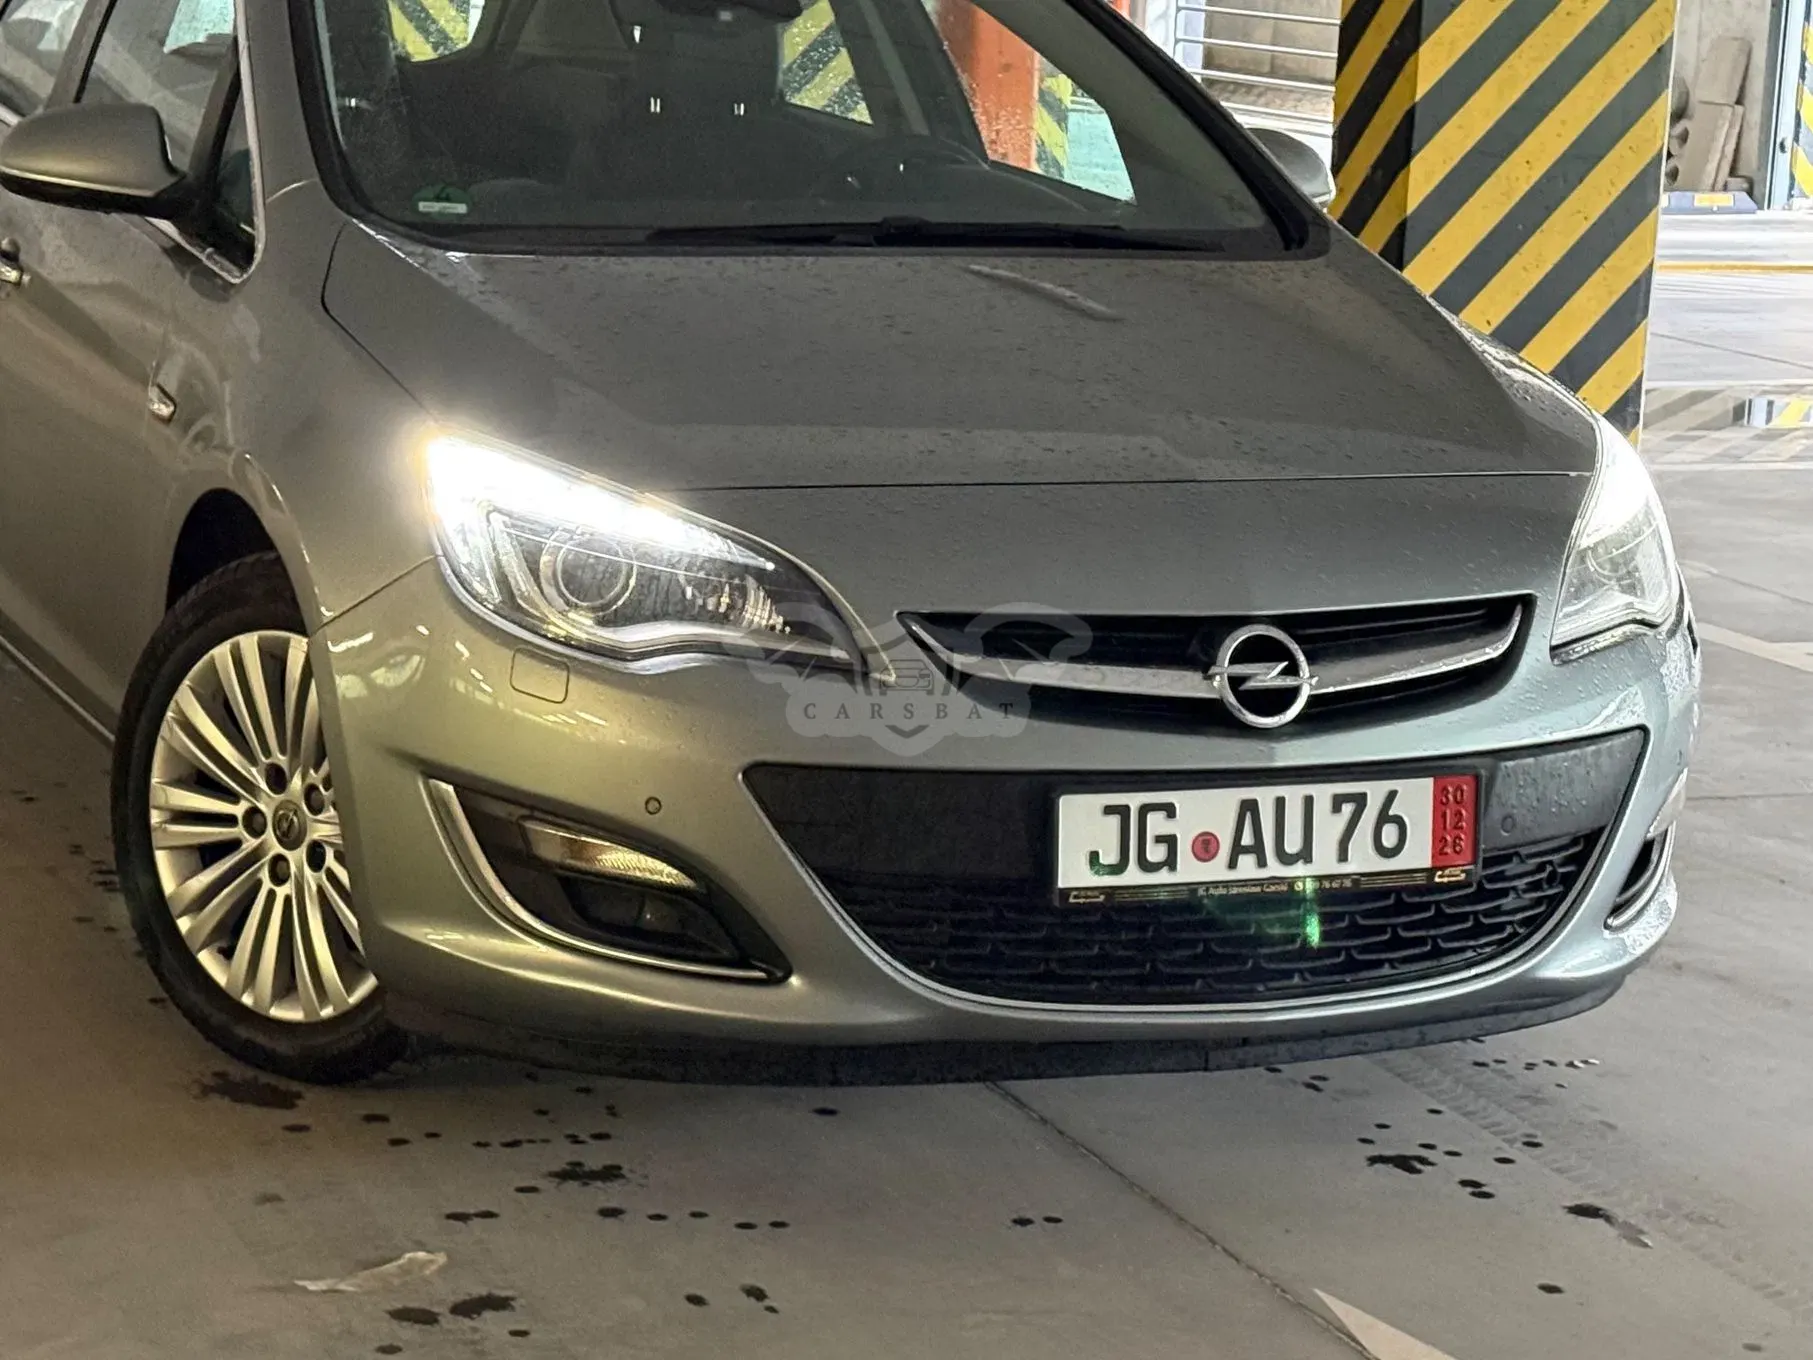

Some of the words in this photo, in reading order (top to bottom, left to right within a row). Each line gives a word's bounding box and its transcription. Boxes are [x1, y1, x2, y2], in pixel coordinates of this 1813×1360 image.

[1440, 784, 1464, 805] 30
[1441, 808, 1464, 831] 12
[1089, 802, 1178, 876] JG
[1228, 794, 1315, 869] AU
[1331, 789, 1407, 863] 76
